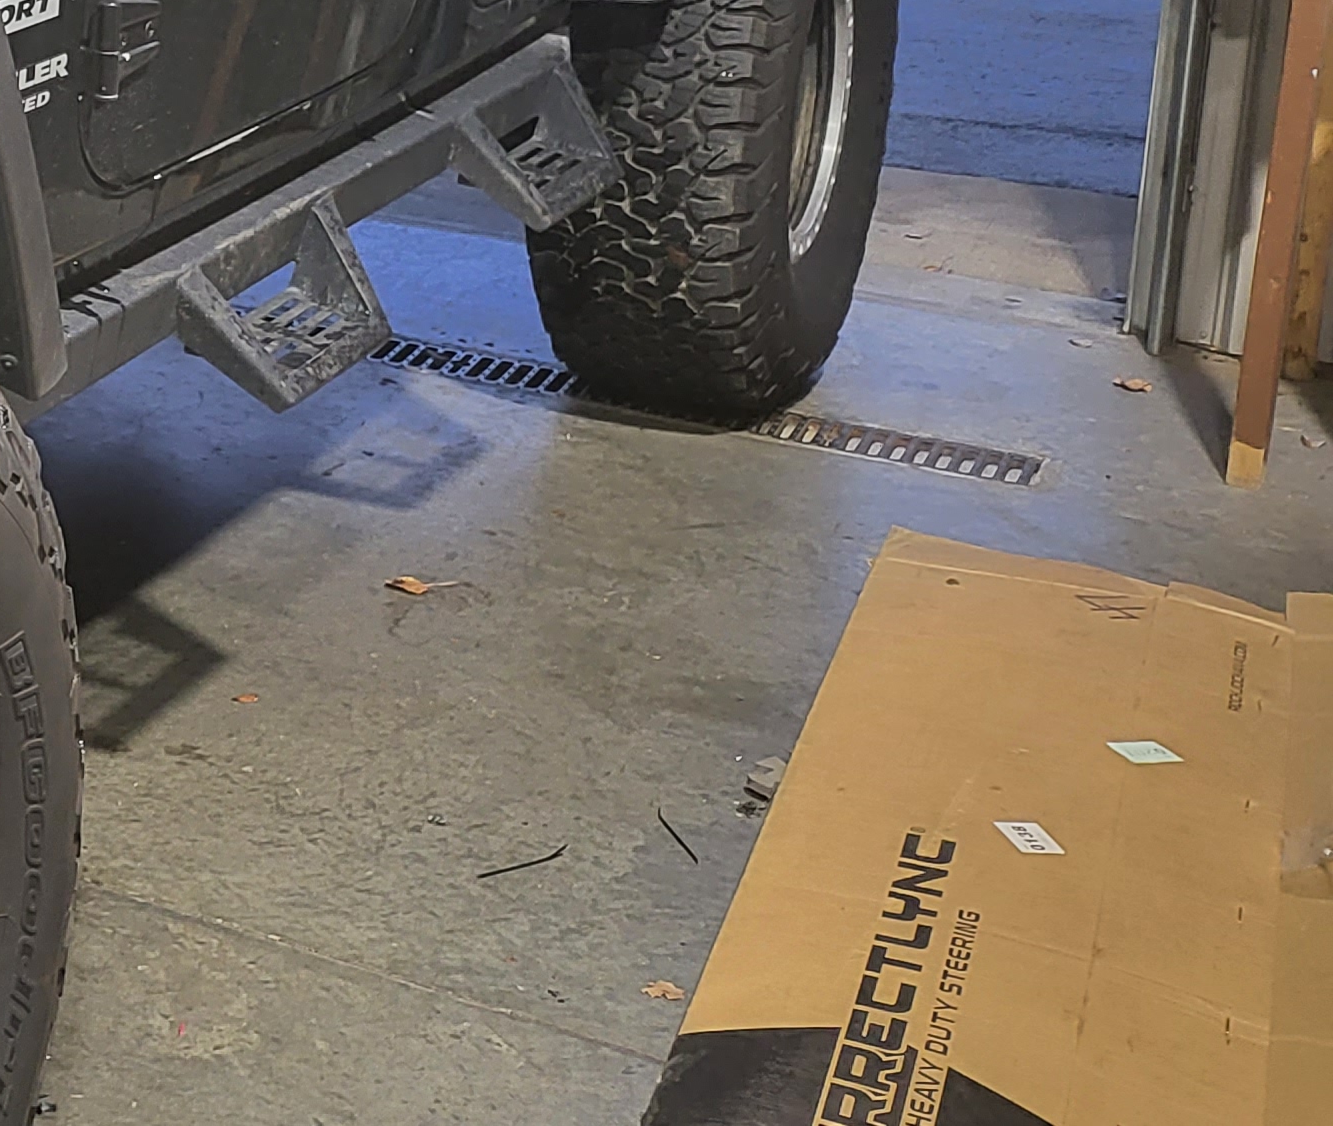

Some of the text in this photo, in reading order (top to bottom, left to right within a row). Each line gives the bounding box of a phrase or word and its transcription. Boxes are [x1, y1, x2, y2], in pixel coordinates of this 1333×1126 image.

[15, 53, 69, 91] LER
[21, 90, 51, 113] ED
[1010, 824, 1047, 853] 0138
[904, 908, 981, 1126] HEAVY DUTY STEERING
